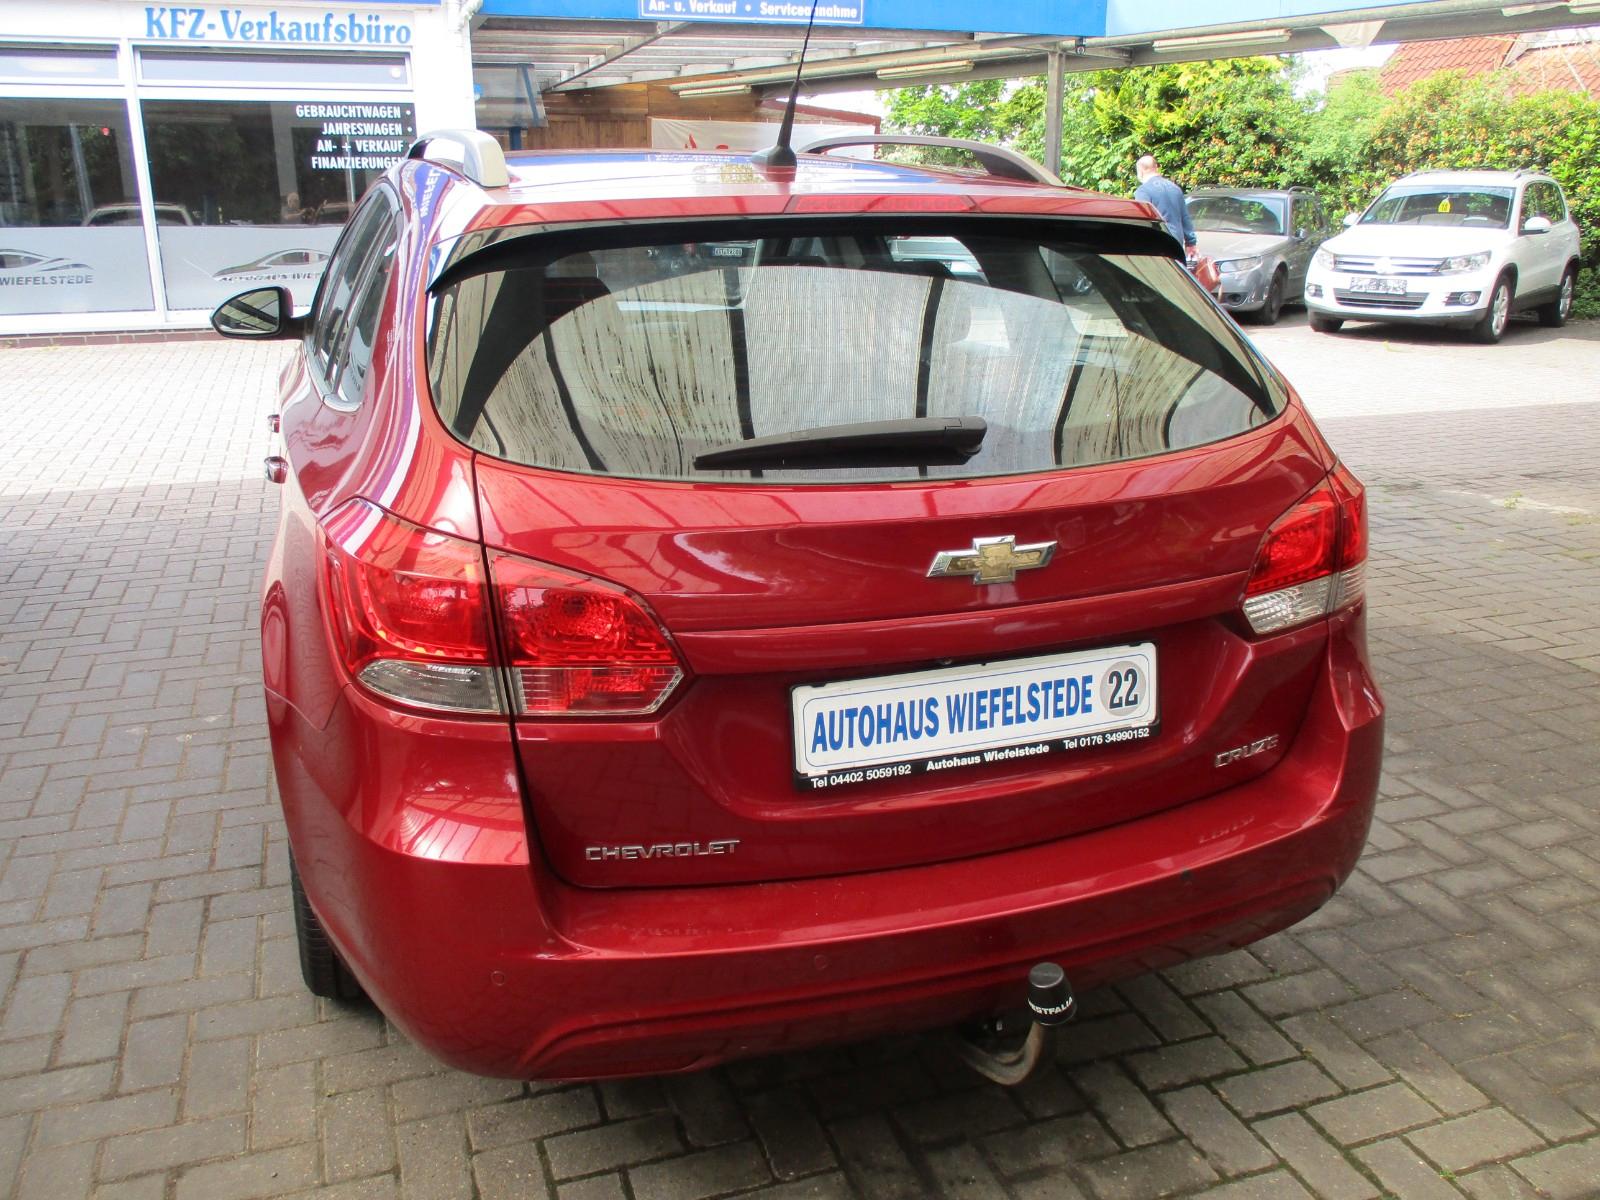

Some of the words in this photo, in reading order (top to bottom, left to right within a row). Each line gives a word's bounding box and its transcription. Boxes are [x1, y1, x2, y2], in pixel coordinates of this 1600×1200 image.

[674, 1, 686, 12] u.
[689, 0, 736, 14] Verkauf
[145, 8, 411, 43] KFZ-Verkaufsbüro
[296, 104, 401, 118] GEBRAUCHTWAGEN
[322, 122, 402, 135] JAHRESWAGEN
[317, 139, 337, 152] AN-
[355, 140, 404, 152] VERKAUF
[0, 275, 94, 286] WIEFELSTEDE
[811, 697, 939, 753] AUTOHAUS
[946, 674, 1093, 734] WIEFELSTEDE
[1107, 667, 1139, 709] 22
[811, 777, 828, 788] Tel
[830, 771, 864, 786] 04402
[866, 764, 912, 780] 5059192
[926, 755, 981, 771] Autohaus
[984, 744, 1050, 762] Wiefelstede
[1063, 738, 1078, 750] Tel
[1080, 735, 1103, 747] 0176
[1105, 728, 1150, 743] 34990152
[1215, 734, 1279, 768] CRUZE
[585, 840, 741, 860] CHEVROLET
